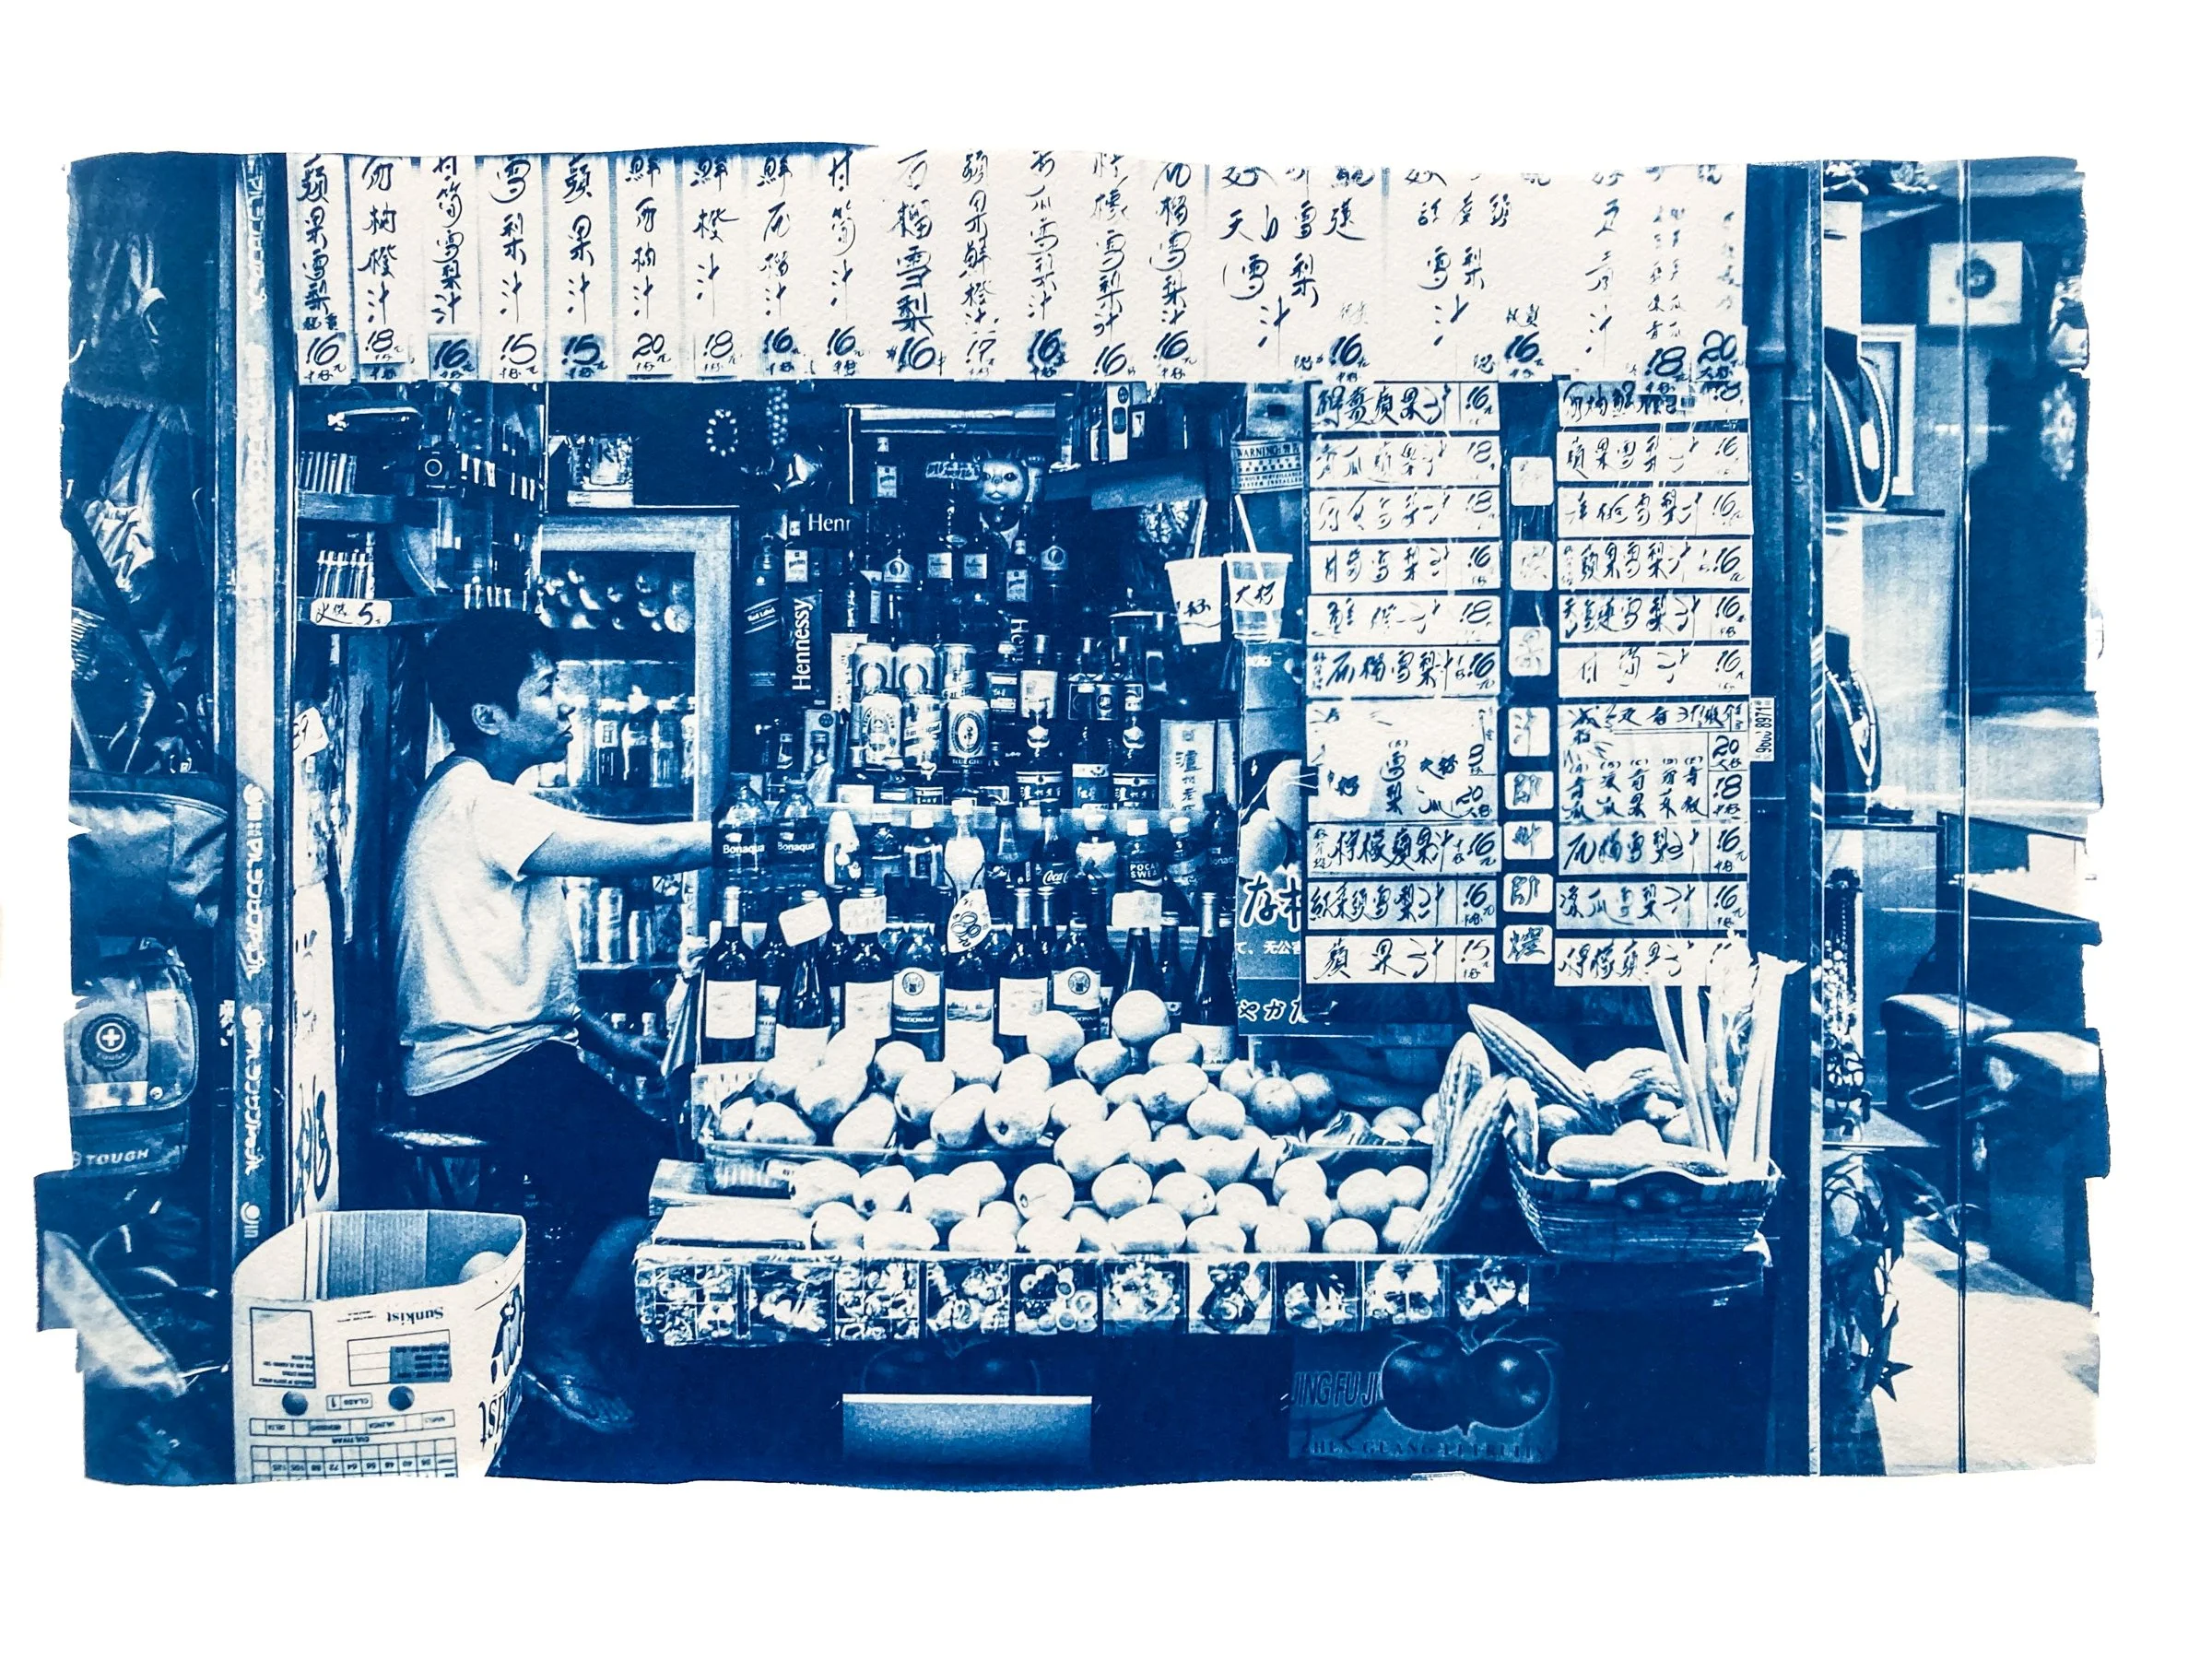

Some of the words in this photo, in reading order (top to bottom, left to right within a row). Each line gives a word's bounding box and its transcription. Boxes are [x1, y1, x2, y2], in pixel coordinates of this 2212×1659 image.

[792, 597, 815, 691] Hennessy
[1755, 707, 1772, 729] 8971
[1712, 735, 1741, 759] 20
[723, 843, 765, 854] Bonaqua
[777, 841, 816, 852] Bonaqua
[86, 1148, 149, 1166] TOUGH
[386, 1306, 444, 1325] Sunkist
